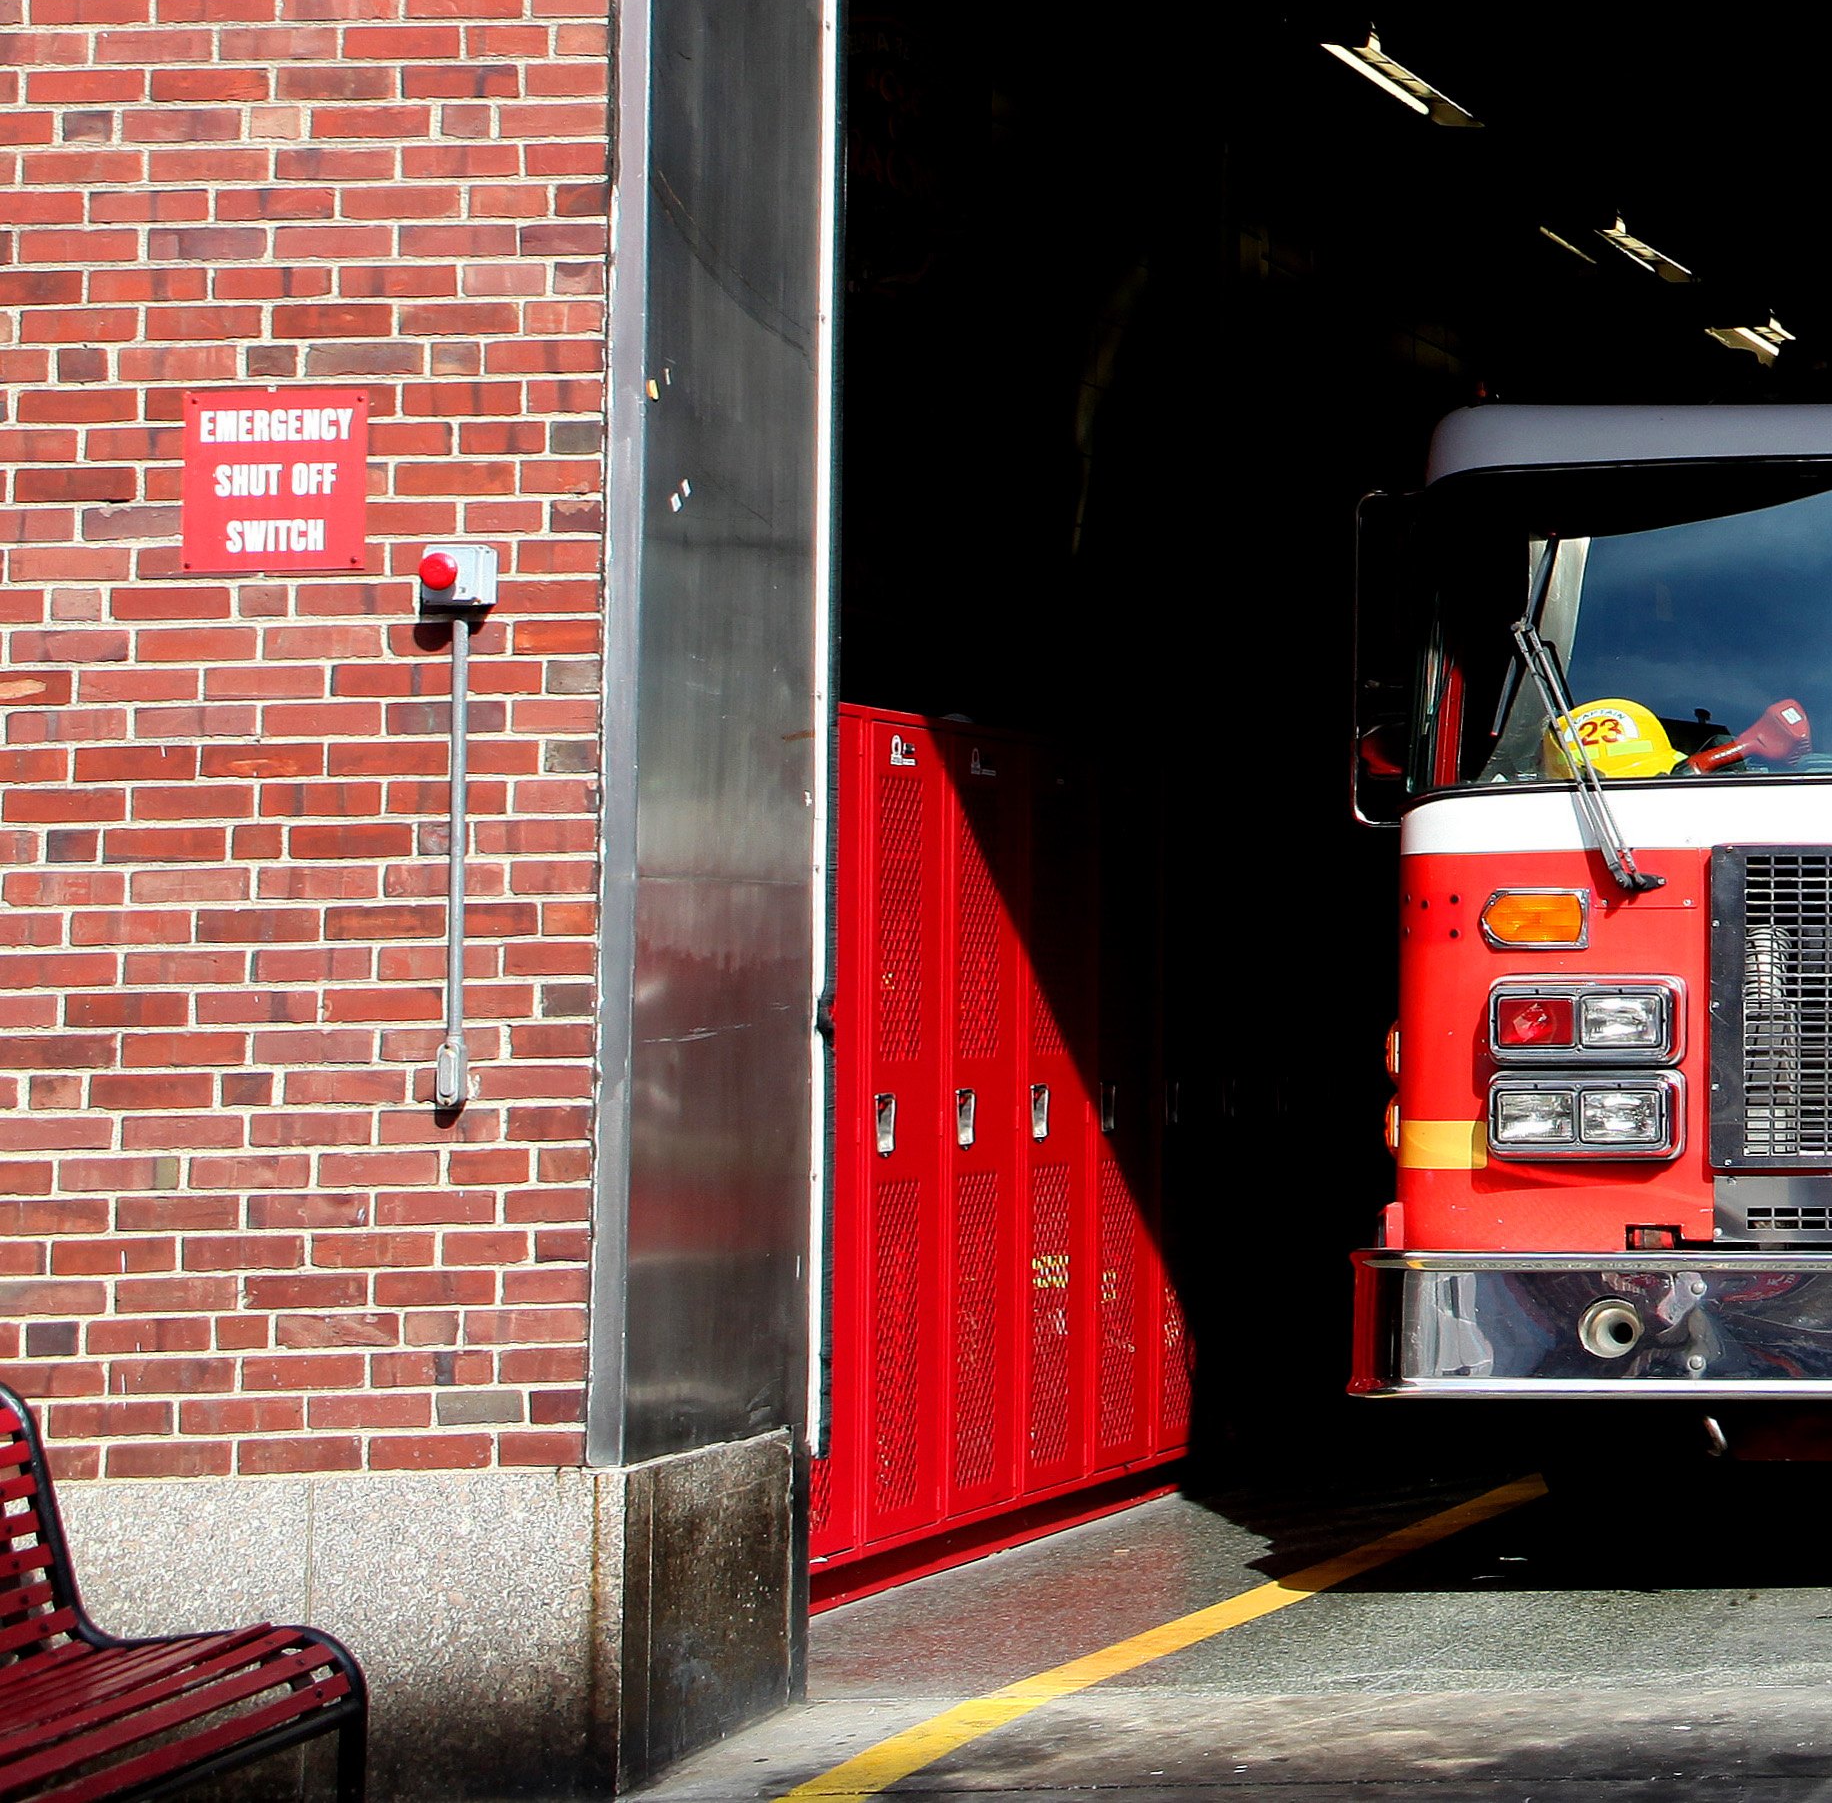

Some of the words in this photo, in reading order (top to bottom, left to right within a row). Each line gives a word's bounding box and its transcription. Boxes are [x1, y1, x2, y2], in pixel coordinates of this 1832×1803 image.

[200, 408, 353, 443] EMERGENCY
[214, 463, 282, 497] SHUT
[291, 462, 337, 495] OFF
[225, 518, 325, 553] SWITCH
[1578, 718, 1622, 746] 23
